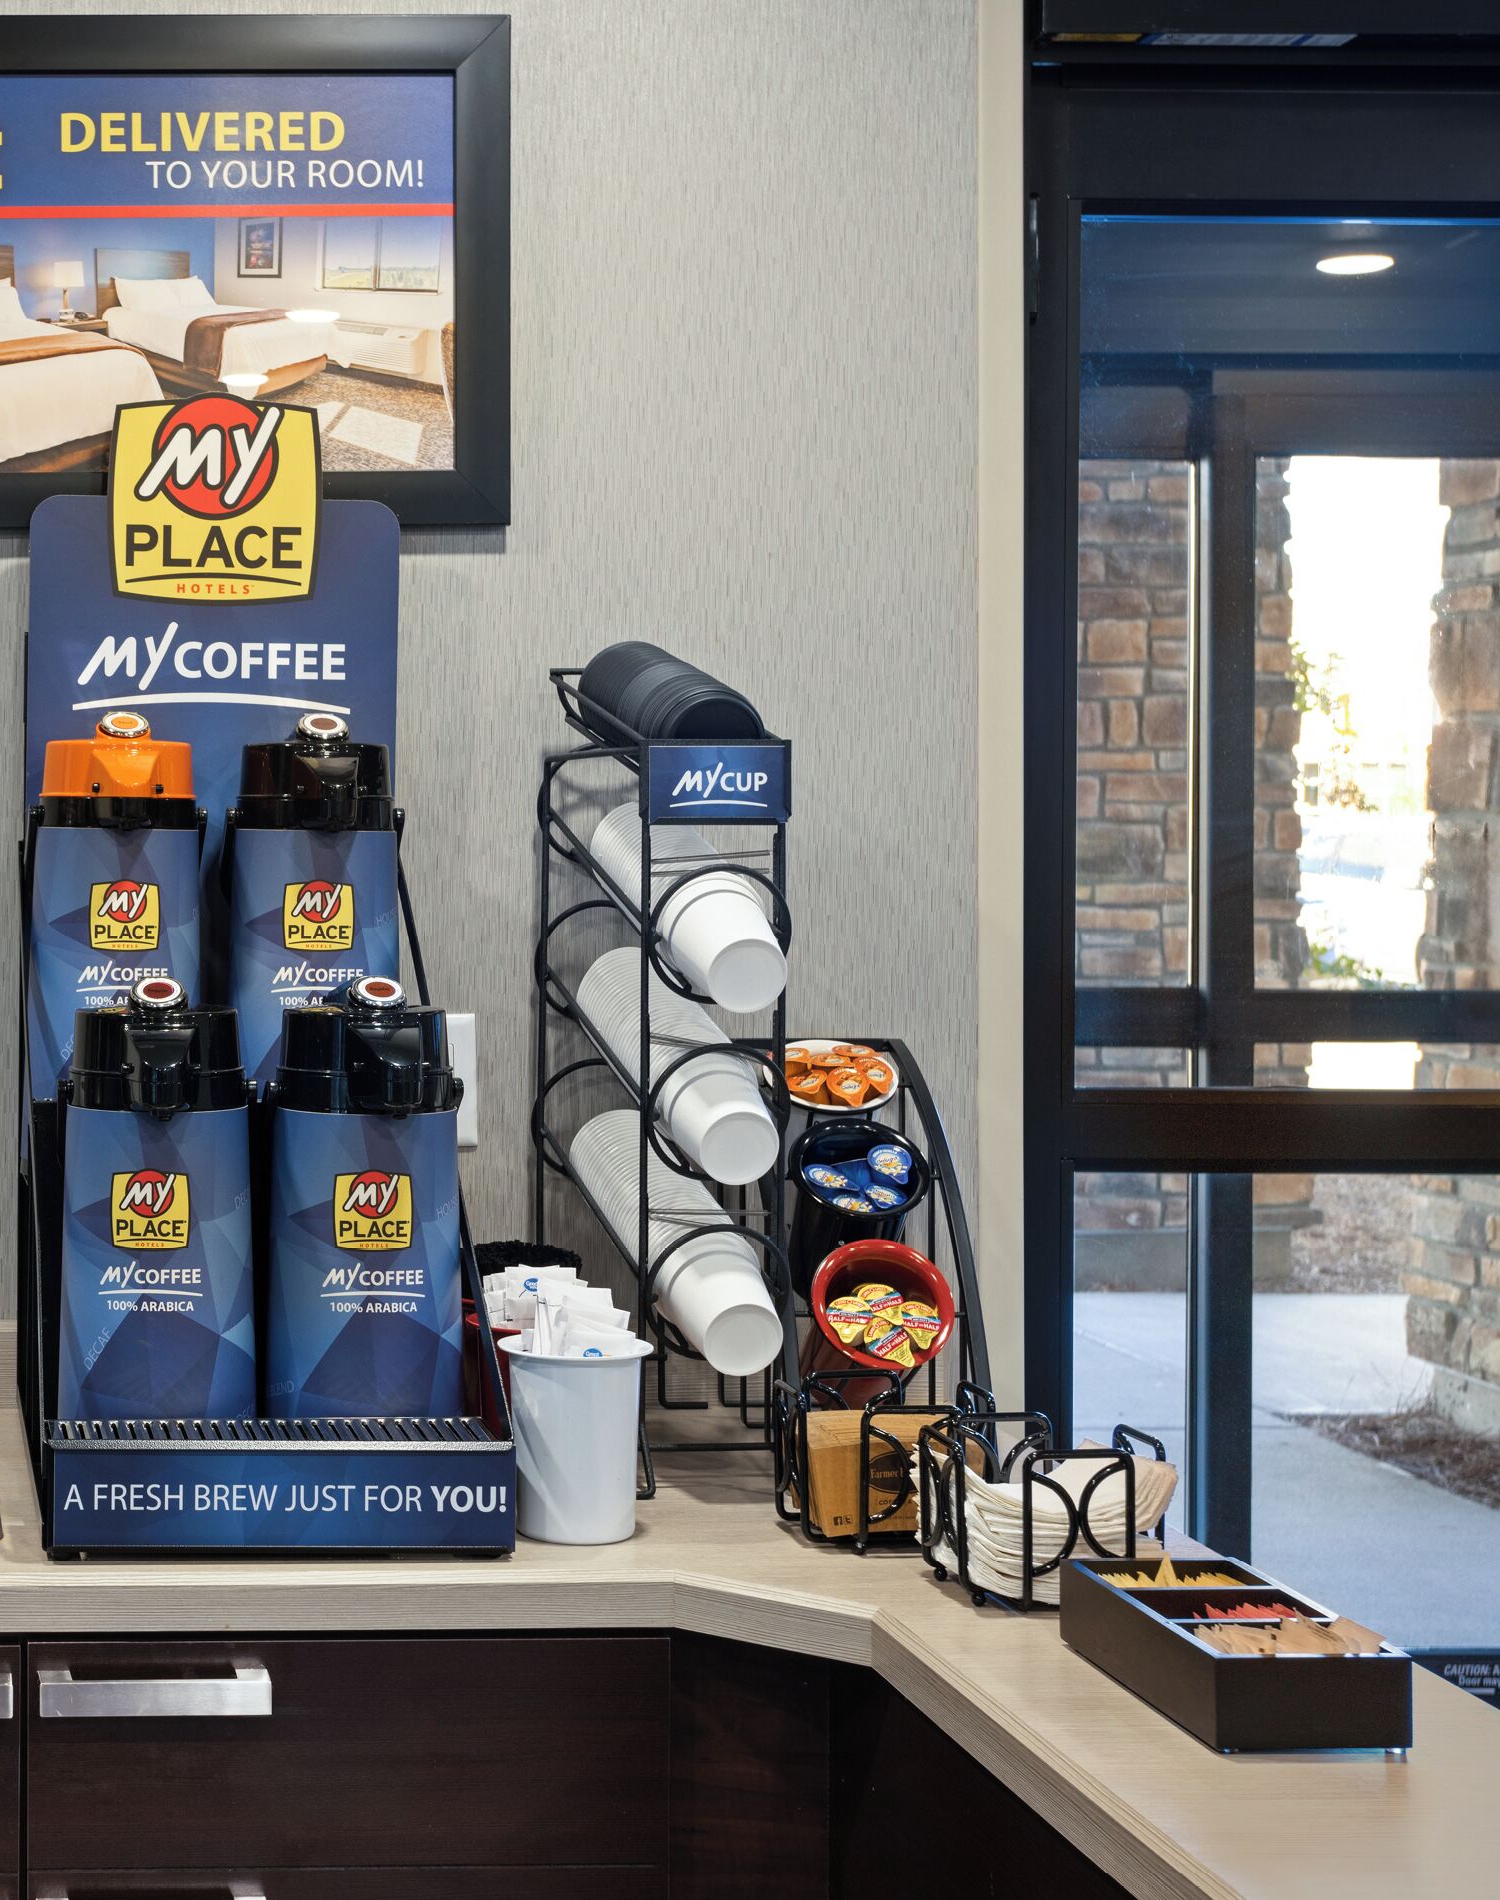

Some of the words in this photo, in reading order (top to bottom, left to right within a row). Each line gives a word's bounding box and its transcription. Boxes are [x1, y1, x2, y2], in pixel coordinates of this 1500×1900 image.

[59, 110, 346, 153] DELIVERED
[146, 160, 190, 189] TO
[200, 160, 296, 189] YOUR
[307, 159, 424, 189] ROOM!
[125, 524, 302, 570] PLACE
[176, 583, 250, 595] HOTELS
[94, 925, 155, 939] PLACE
[288, 925, 350, 939] PLACE
[84, 996, 114, 1006] 100%
[279, 996, 309, 1006] 100%
[116, 1219, 184, 1237] PLACE
[339, 1220, 408, 1238] PLACE
[107, 1300, 138, 1312] 100%
[140, 1301, 194, 1312] ARABICA
[330, 1302, 363, 1313] 100%
[365, 1302, 418, 1313] ARABICA
[83, 1327, 111, 1371] DECAF
[870, 1468, 899, 1479] Farmer
[63, 1484, 84, 1510] A
[93, 1483, 184, 1511] FRESH
[194, 1484, 278, 1511] BREW
[284, 1485, 356, 1512] JUST
[364, 1485, 422, 1512] FOR
[431, 1485, 507, 1513] YOU!
[1459, 1675, 1481, 1687] Door
